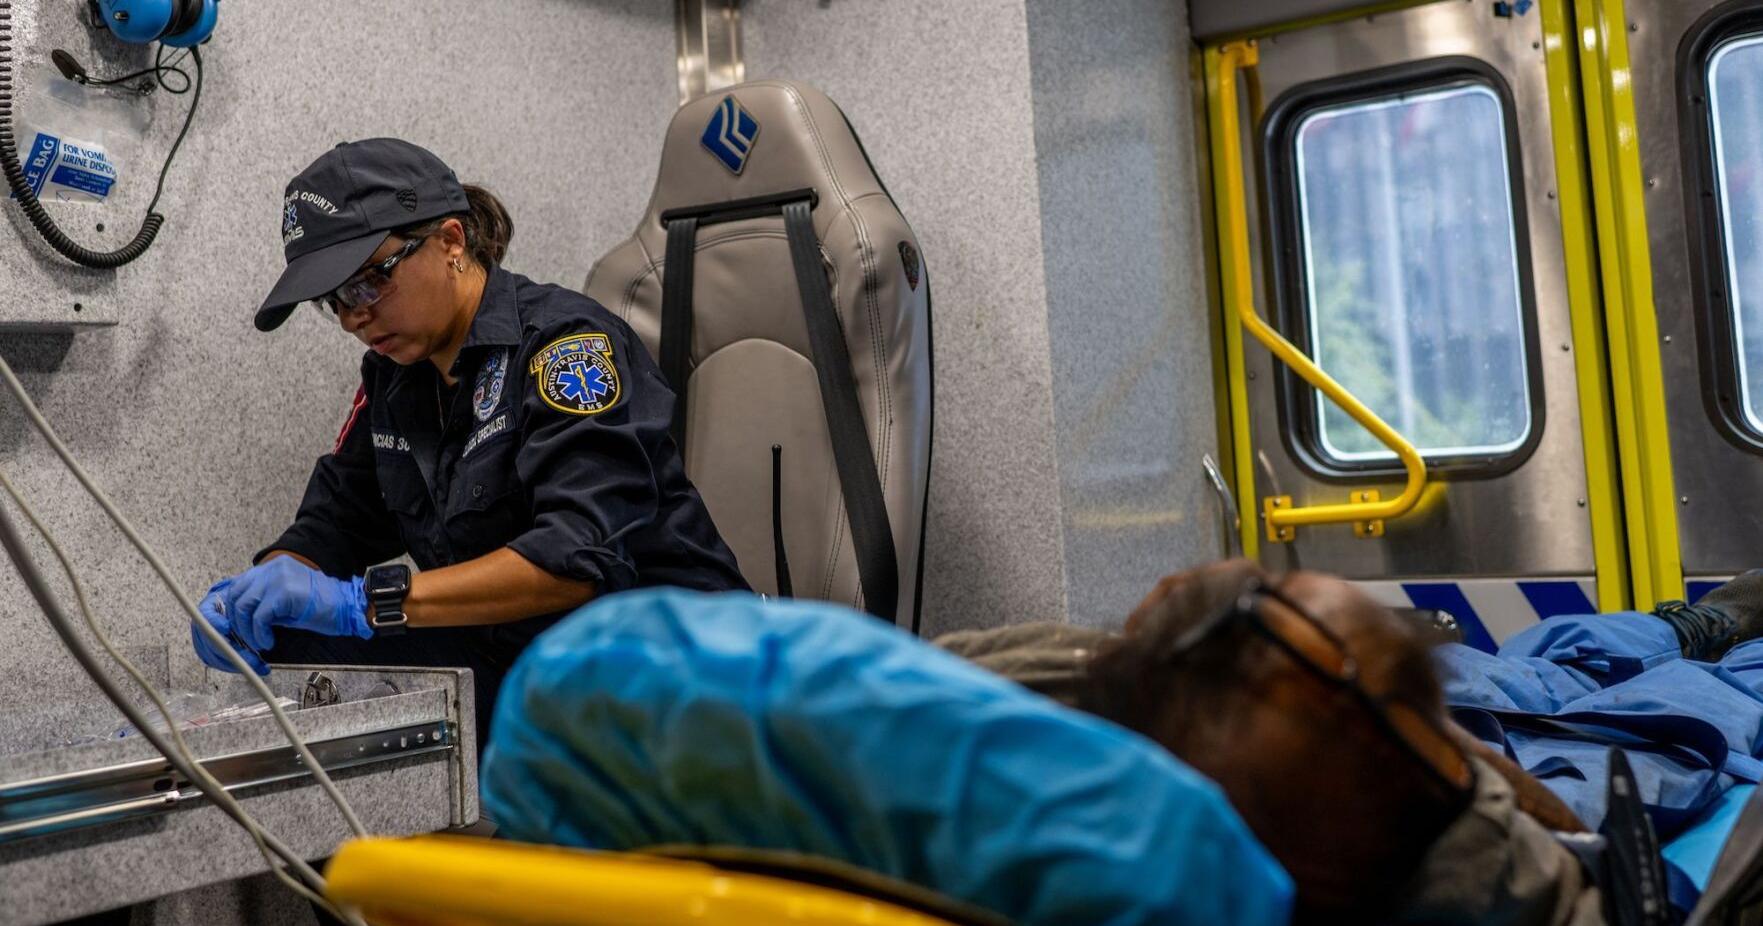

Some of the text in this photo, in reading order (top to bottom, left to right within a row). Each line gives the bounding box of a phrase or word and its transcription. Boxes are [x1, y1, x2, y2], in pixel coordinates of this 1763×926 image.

[33, 139, 55, 169] BAG
[62, 153, 88, 168] URINE
[63, 143, 107, 162] FOR VOMI
[300, 191, 338, 215] COUNTY
[591, 357, 616, 392] COUNTY
[578, 401, 604, 411] EMS
